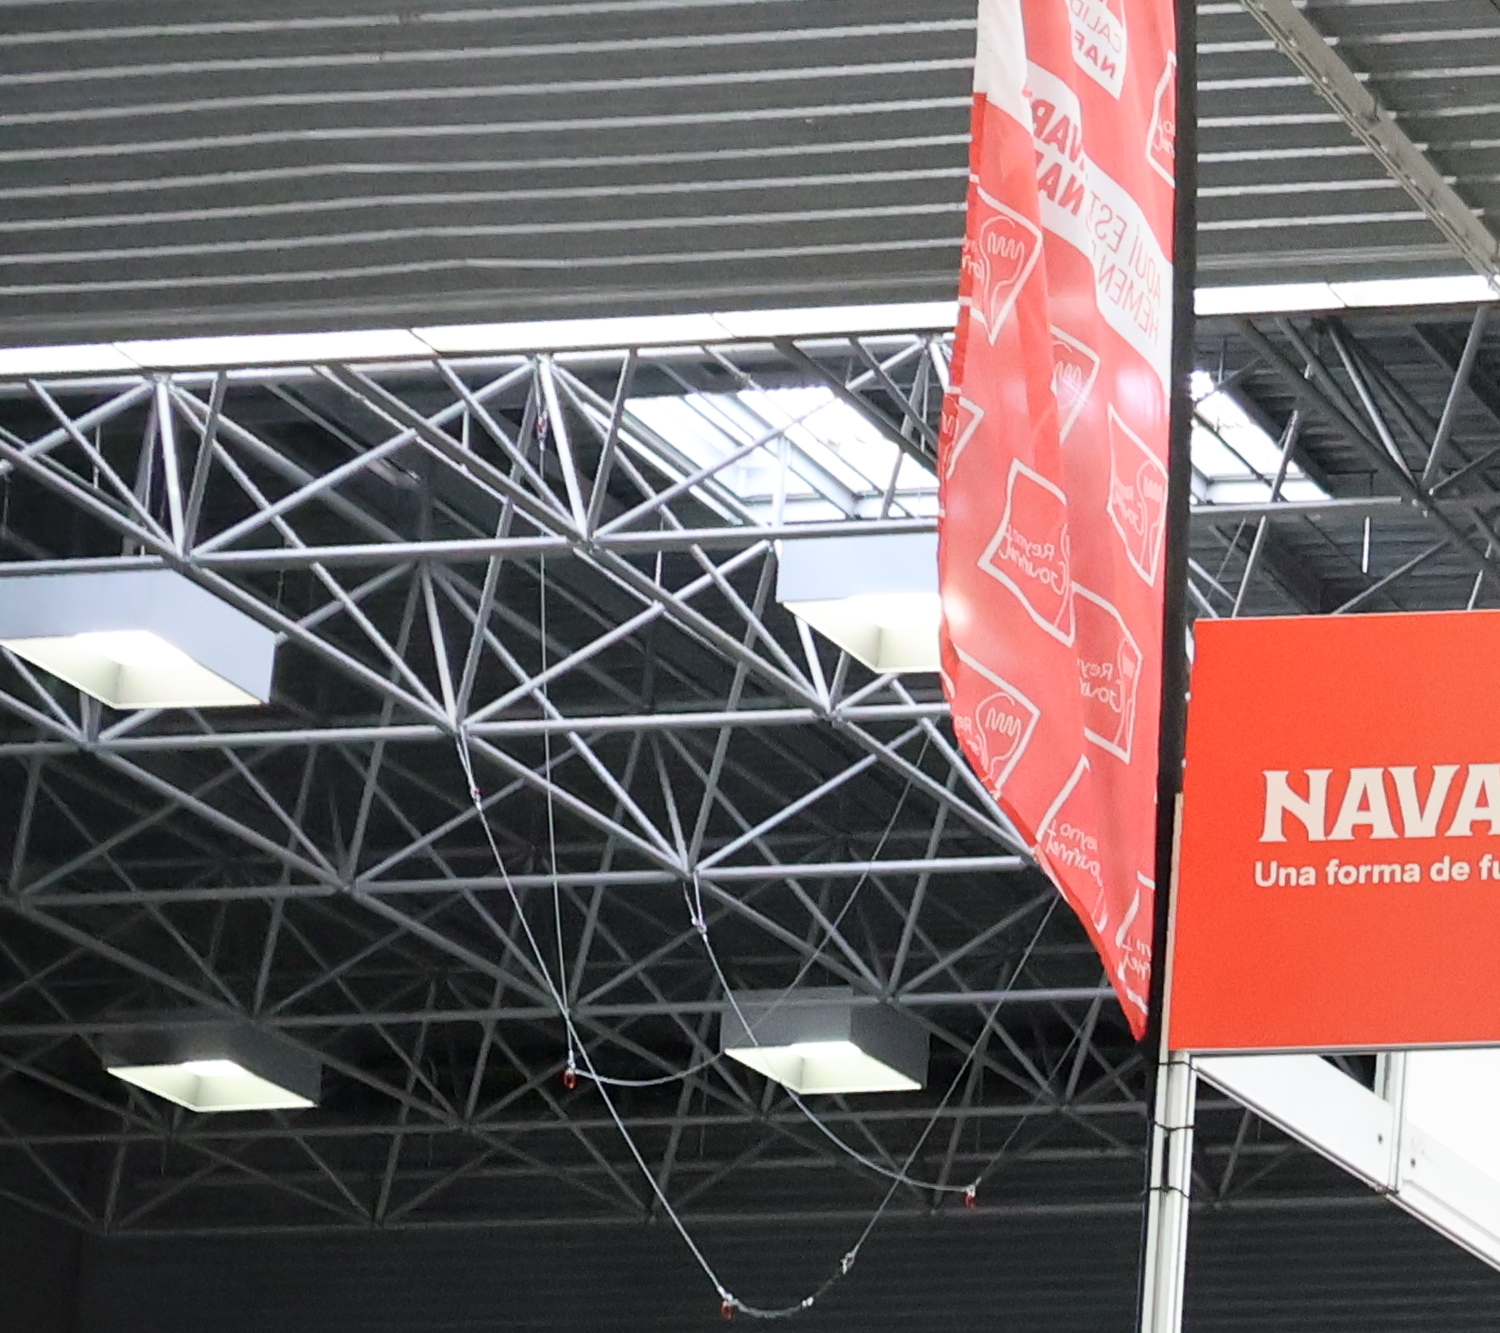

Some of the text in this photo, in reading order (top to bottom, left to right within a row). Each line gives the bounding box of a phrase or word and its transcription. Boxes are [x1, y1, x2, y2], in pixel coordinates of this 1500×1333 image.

[1255, 860, 1316, 887] Una
[1325, 855, 1420, 885] forma
[1430, 855, 1470, 882] de
